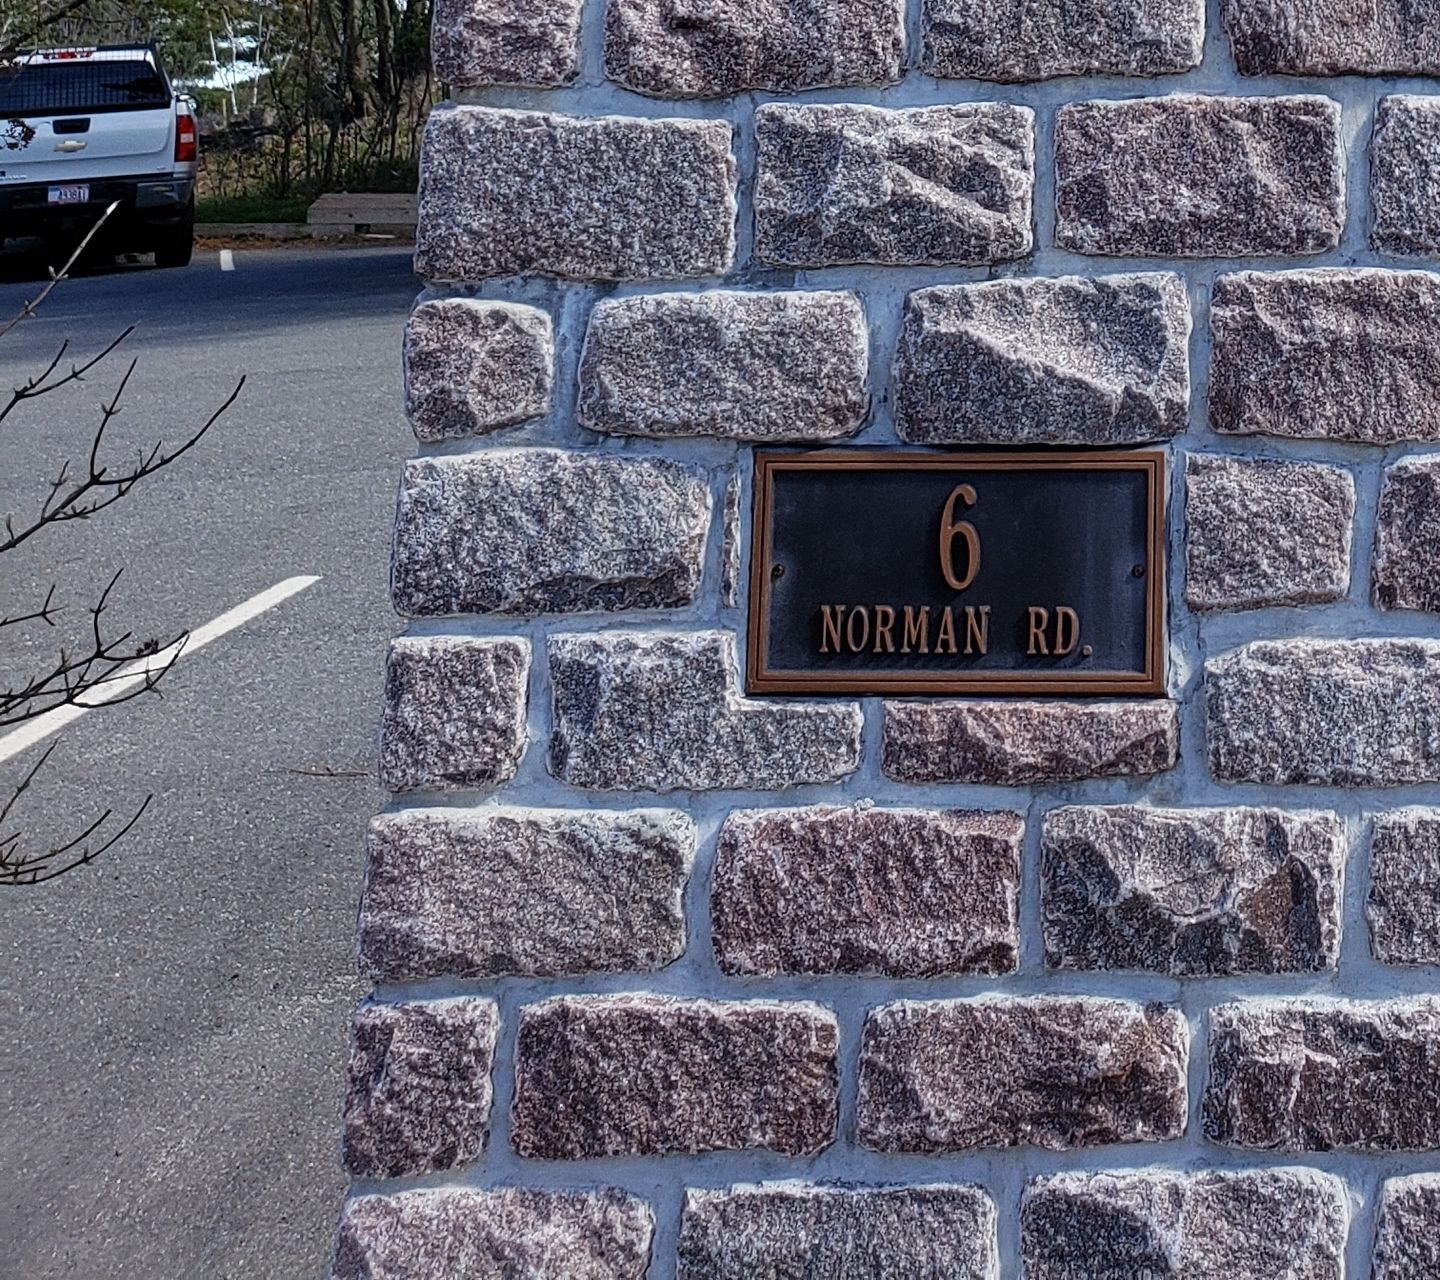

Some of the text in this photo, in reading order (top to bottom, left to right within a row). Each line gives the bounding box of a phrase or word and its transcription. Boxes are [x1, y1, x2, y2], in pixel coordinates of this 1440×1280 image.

[939, 482, 981, 591] 6
[819, 604, 1094, 656] NORMAN RD.
